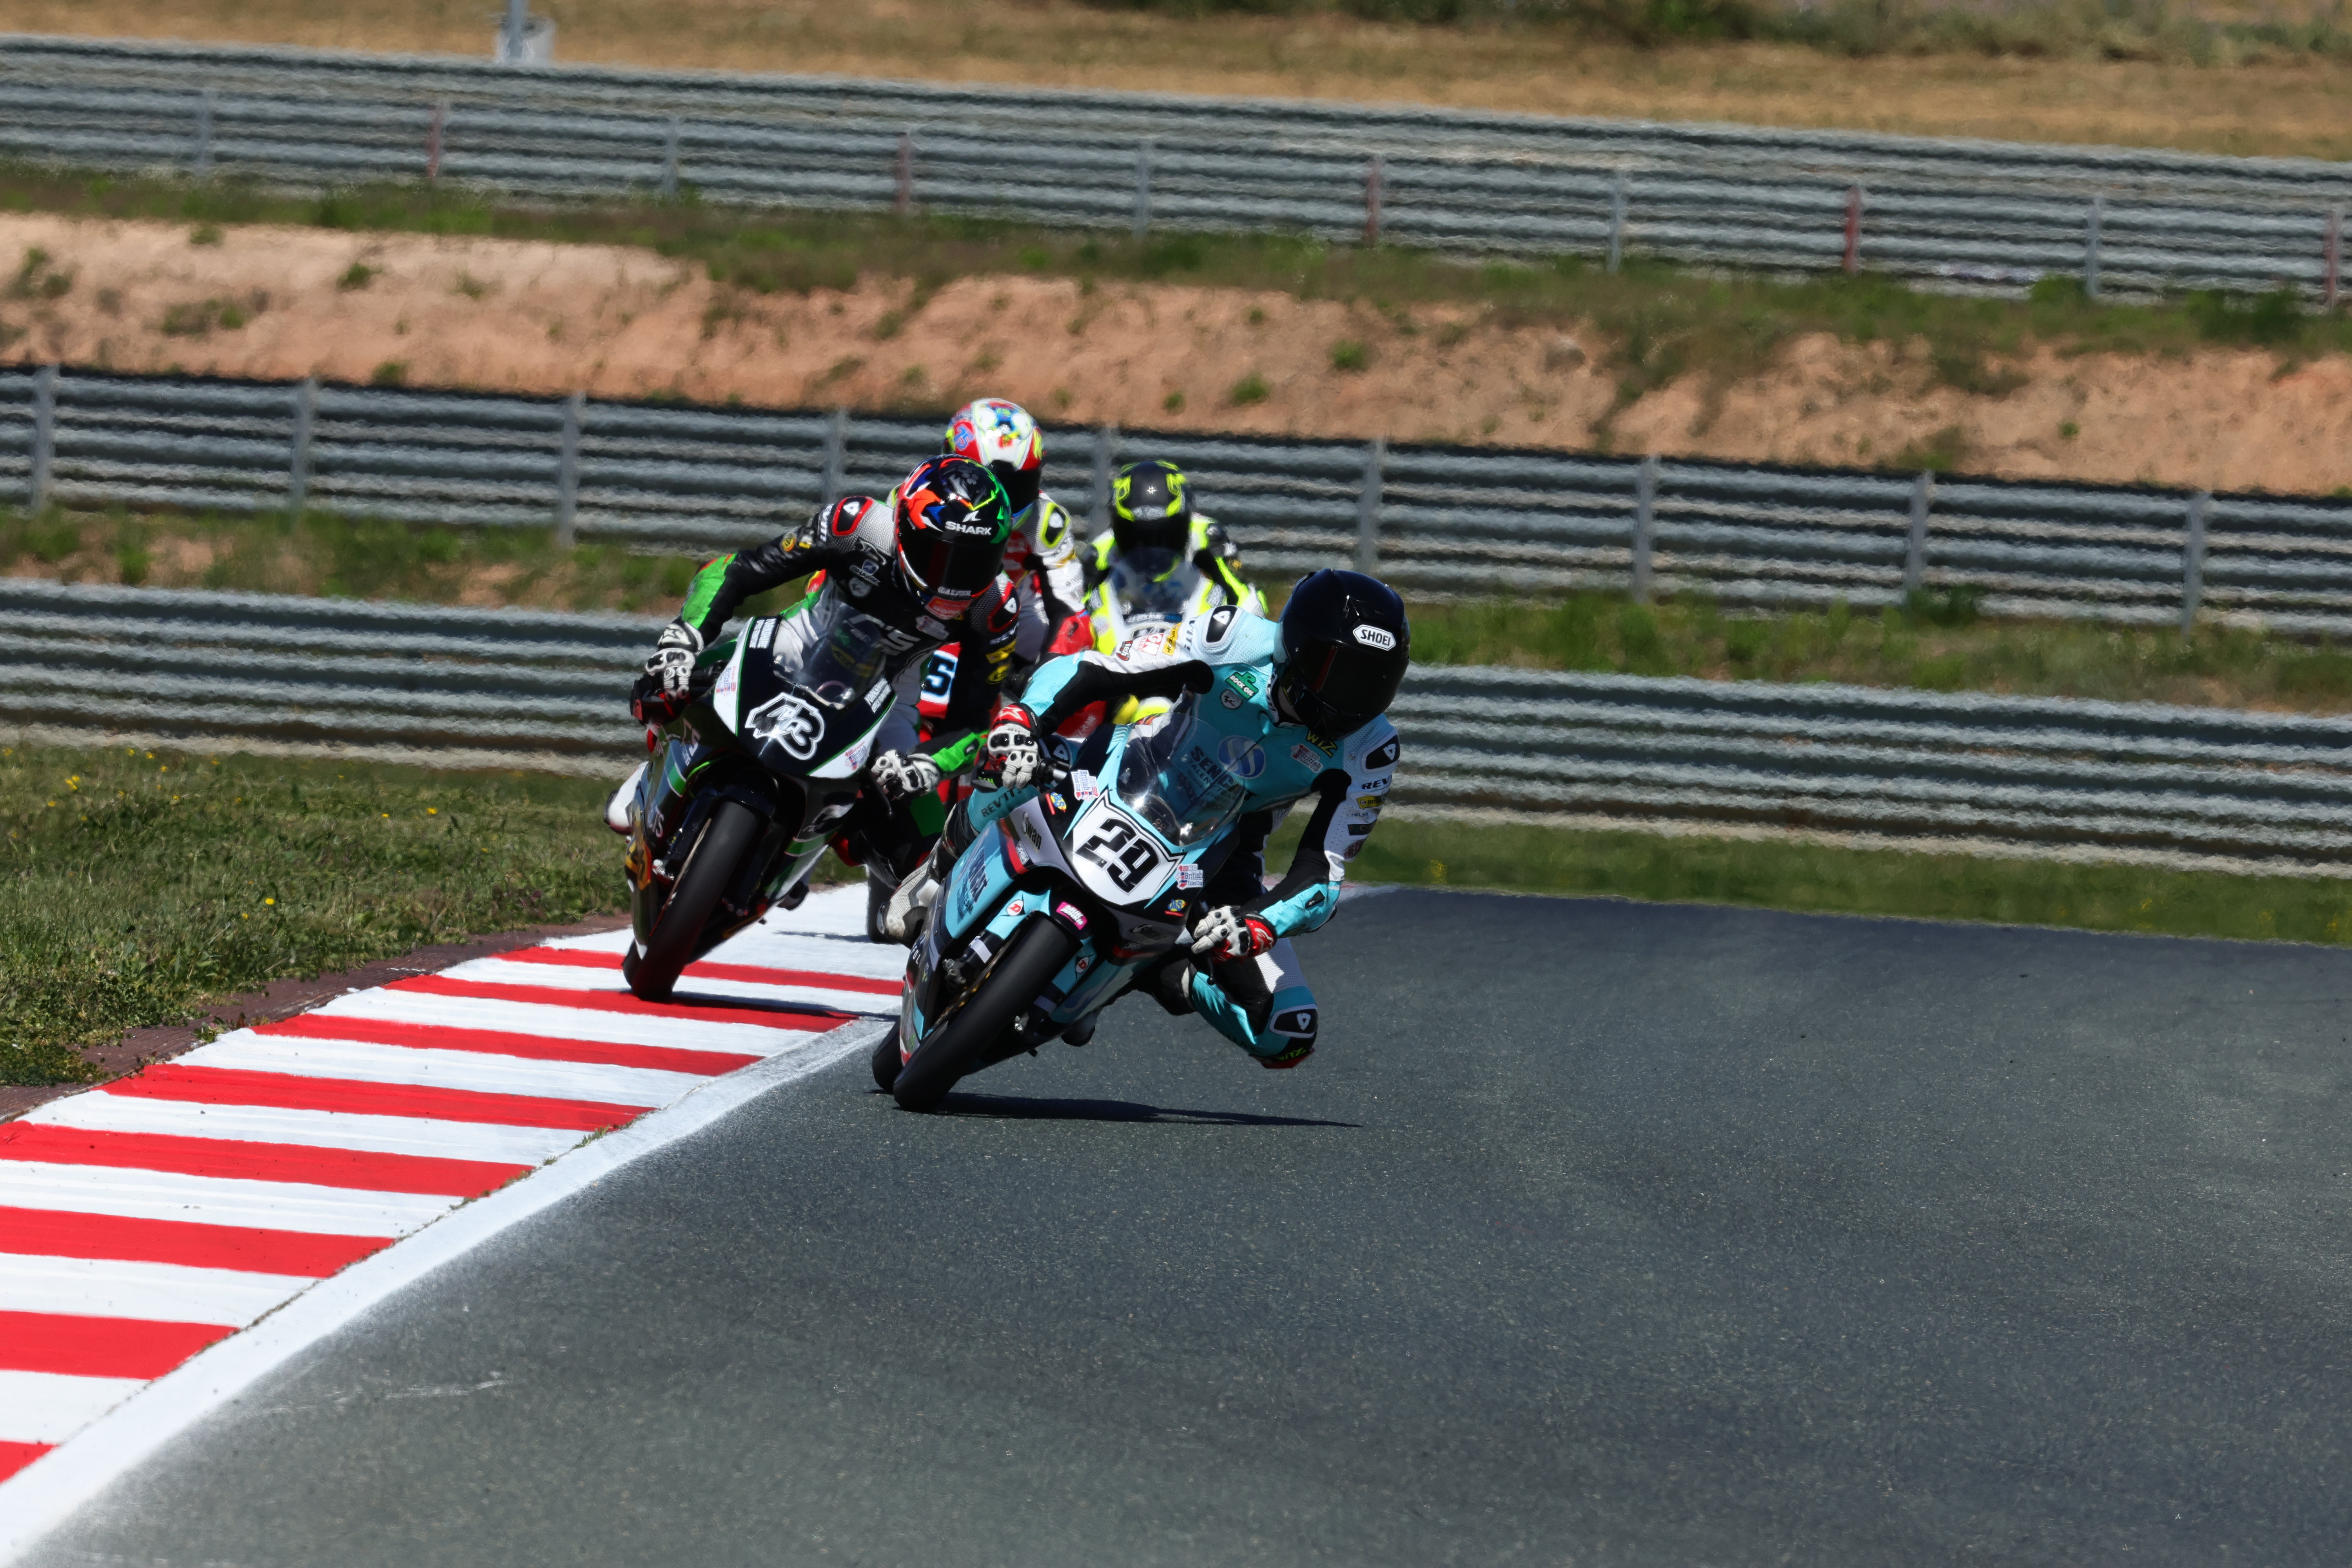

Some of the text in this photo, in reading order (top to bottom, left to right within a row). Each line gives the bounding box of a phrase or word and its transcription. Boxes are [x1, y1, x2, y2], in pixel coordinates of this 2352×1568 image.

[945, 520, 992, 535] SHARK
[1360, 629, 1392, 647] SHOEI
[1229, 675, 1254, 697] ROCK OIL
[1080, 771, 1091, 790] British
[1023, 811, 1042, 851] Swan
[1074, 817, 1159, 894] 29
[1010, 903, 1021, 913] D
[1078, 959, 1087, 970] D
